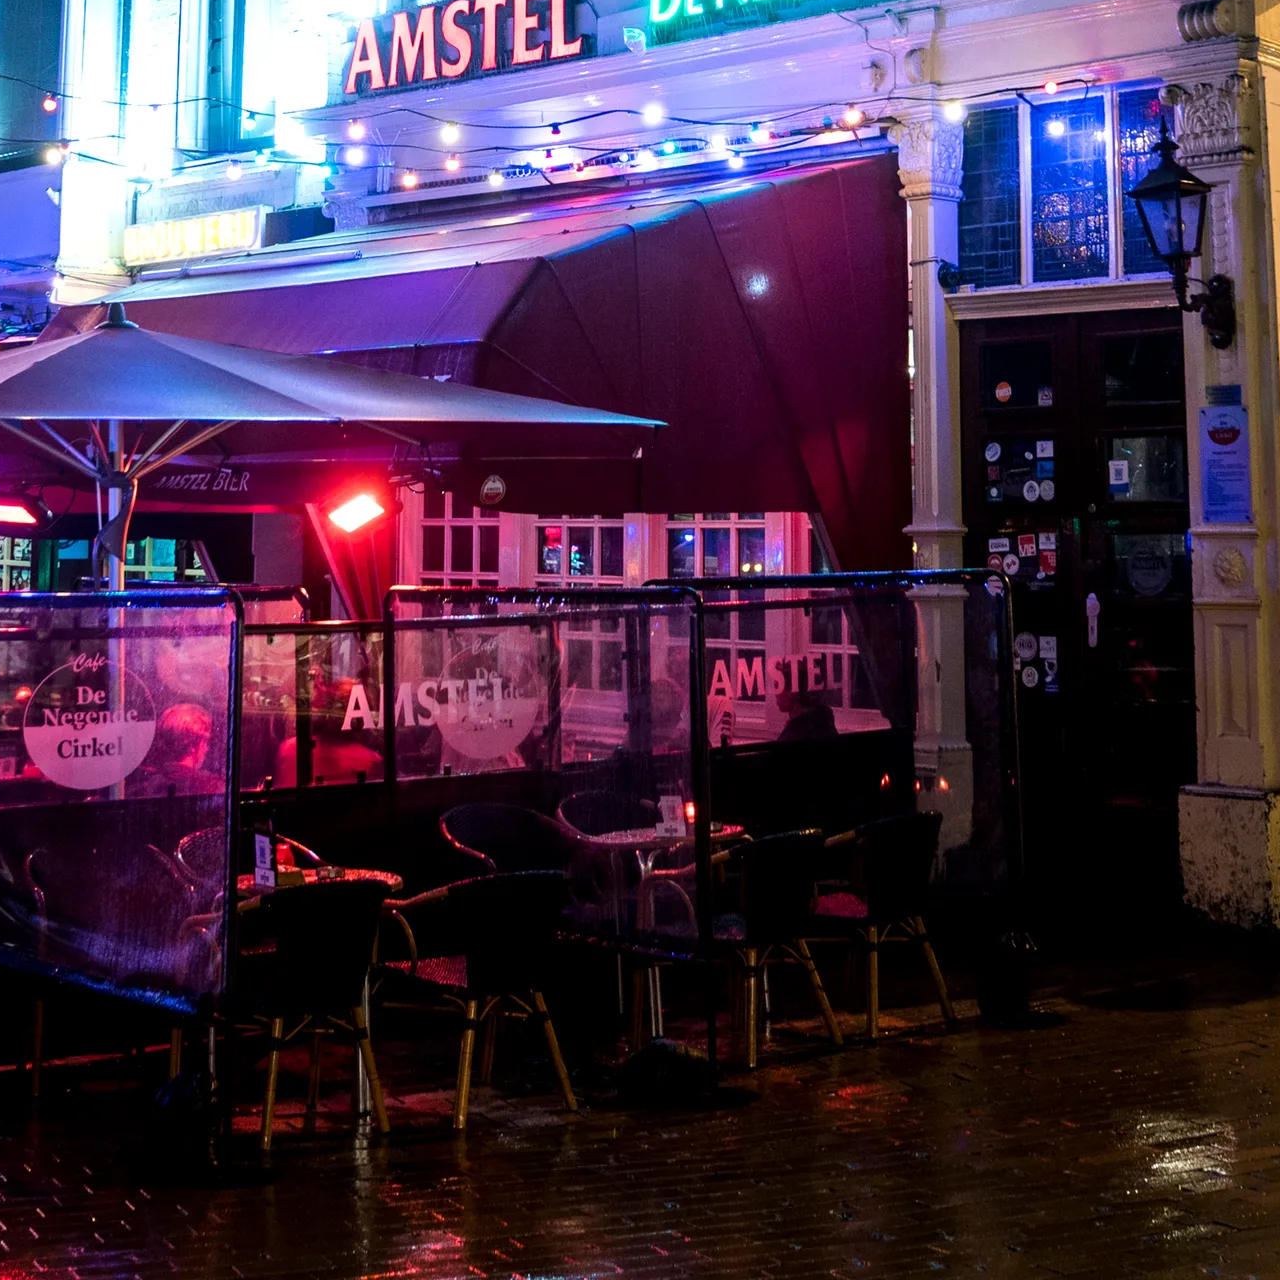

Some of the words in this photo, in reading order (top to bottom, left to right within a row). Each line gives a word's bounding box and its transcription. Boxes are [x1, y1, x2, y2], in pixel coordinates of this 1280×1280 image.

[707, 651, 844, 700] AMSTEL
[76, 685, 107, 706] De
[42, 707, 139, 731] Negende
[56, 736, 125, 759] Cirkel
